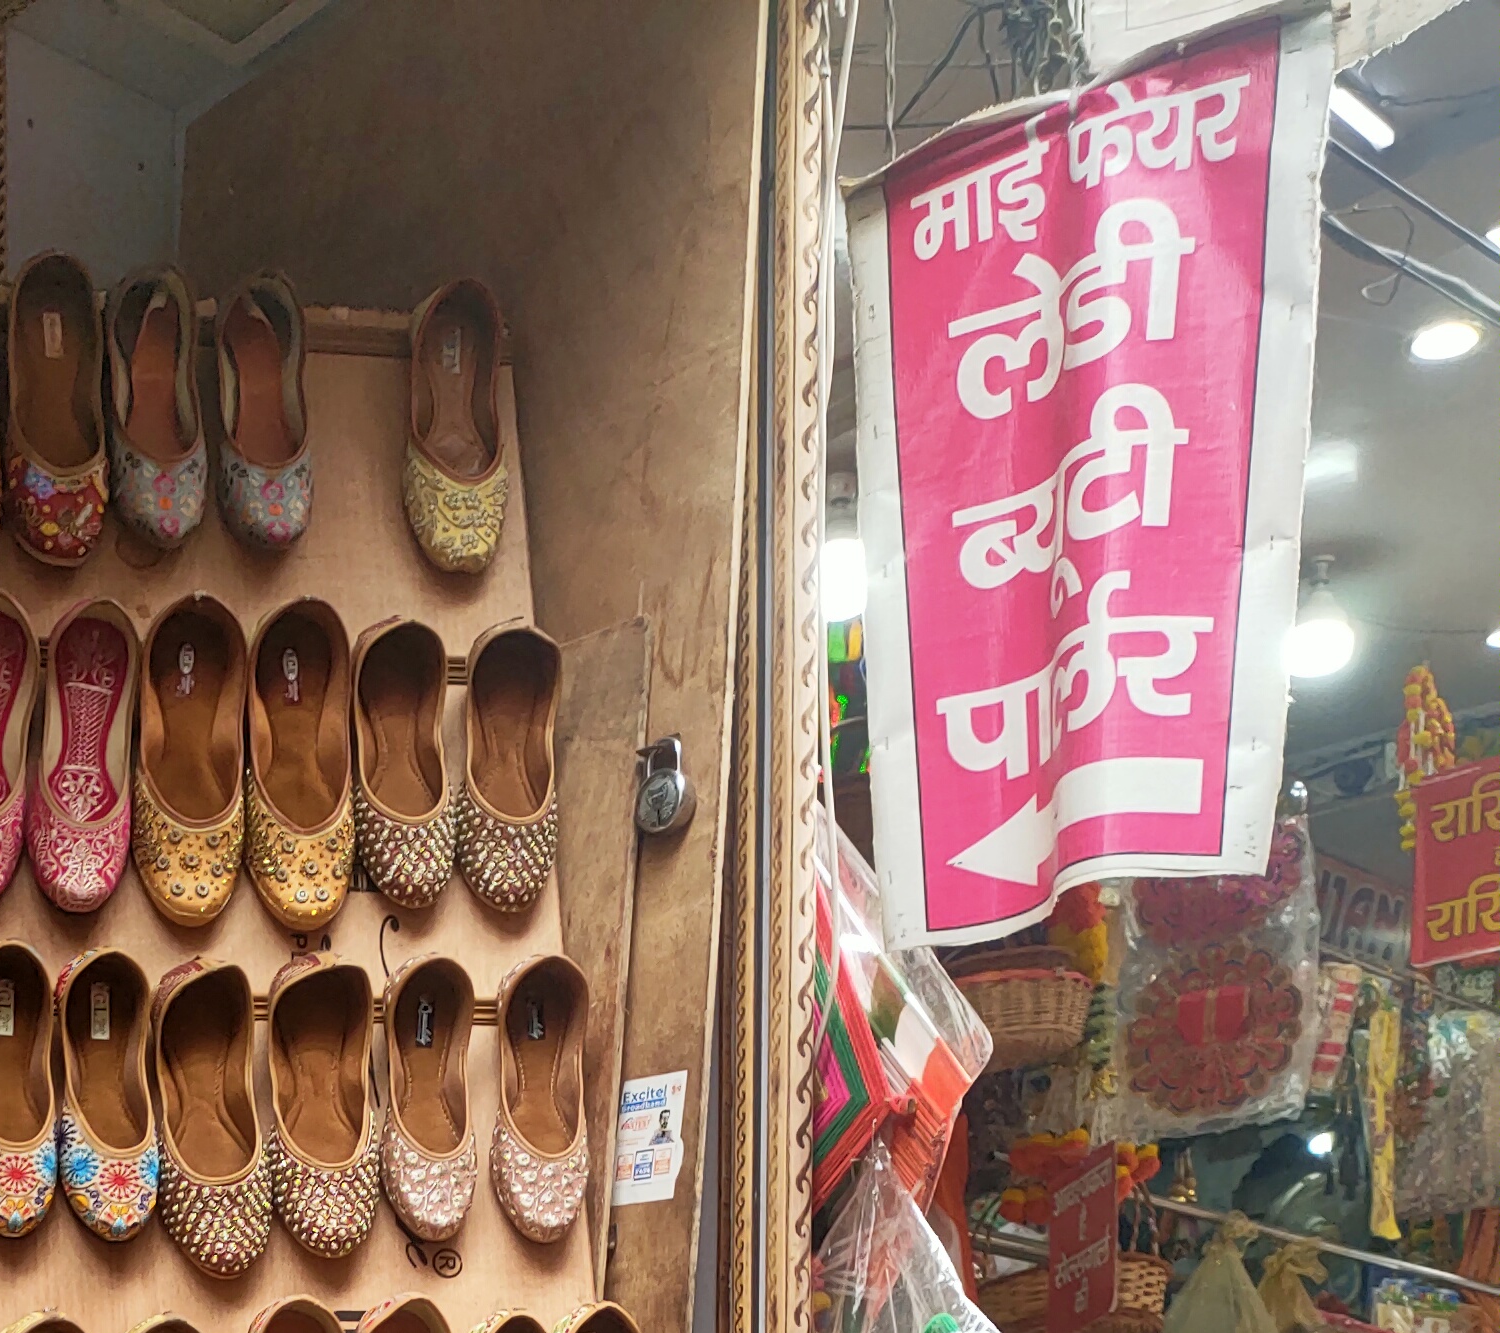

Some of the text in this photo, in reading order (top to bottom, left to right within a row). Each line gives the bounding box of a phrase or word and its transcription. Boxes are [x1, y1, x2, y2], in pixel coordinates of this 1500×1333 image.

[910, 73, 1250, 261] माई फेयर
[948, 197, 1195, 421] लेडी
[952, 383, 1189, 617] ब्यूटी
[937, 571, 1214, 781] पार्लर
[623, 1084, 668, 1104] Excitel
